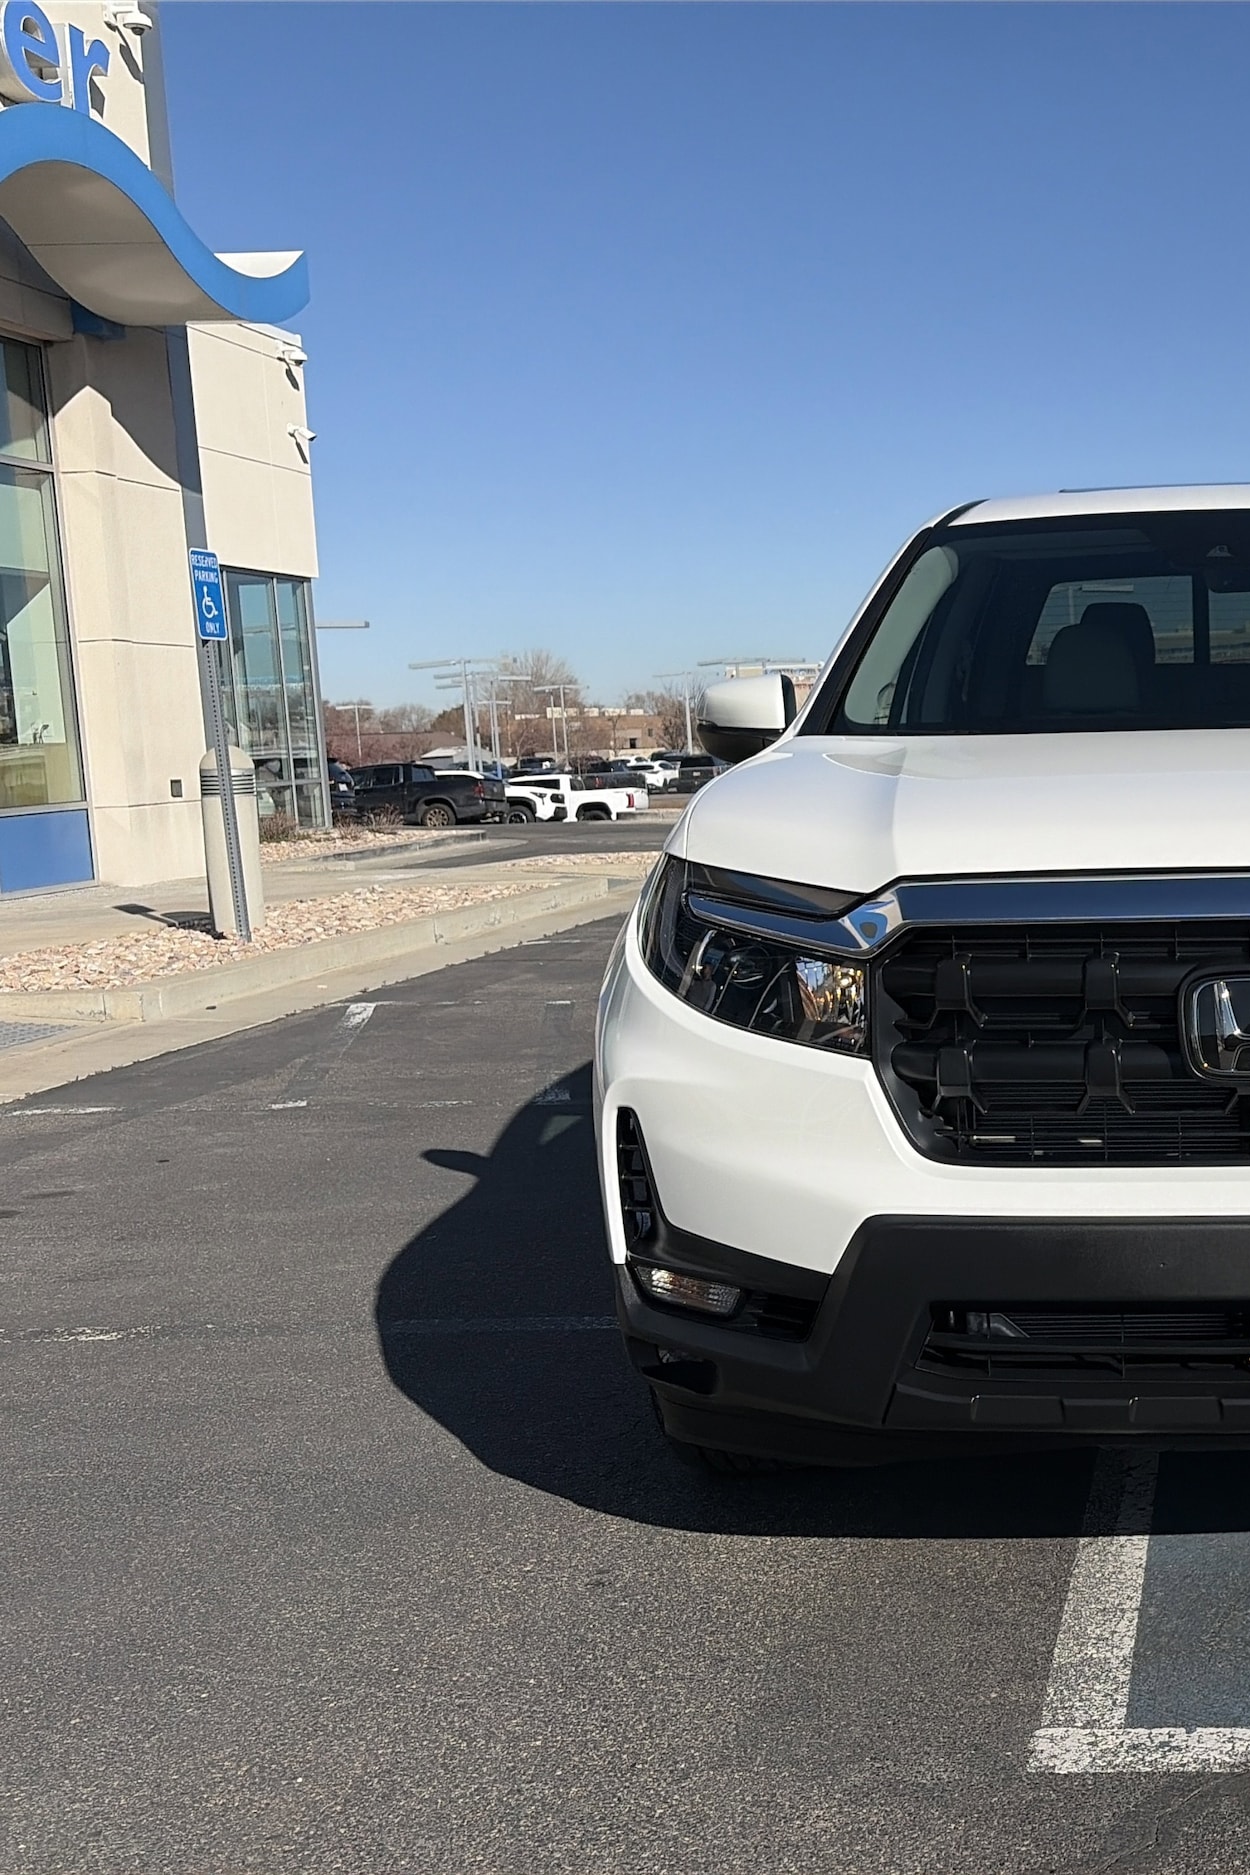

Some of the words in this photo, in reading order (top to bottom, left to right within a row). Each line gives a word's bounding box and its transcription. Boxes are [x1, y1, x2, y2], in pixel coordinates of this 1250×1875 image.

[190, 554, 218, 569] RESERVED
[194, 569, 219, 584] PARKING
[205, 621, 220, 634] ONLY
